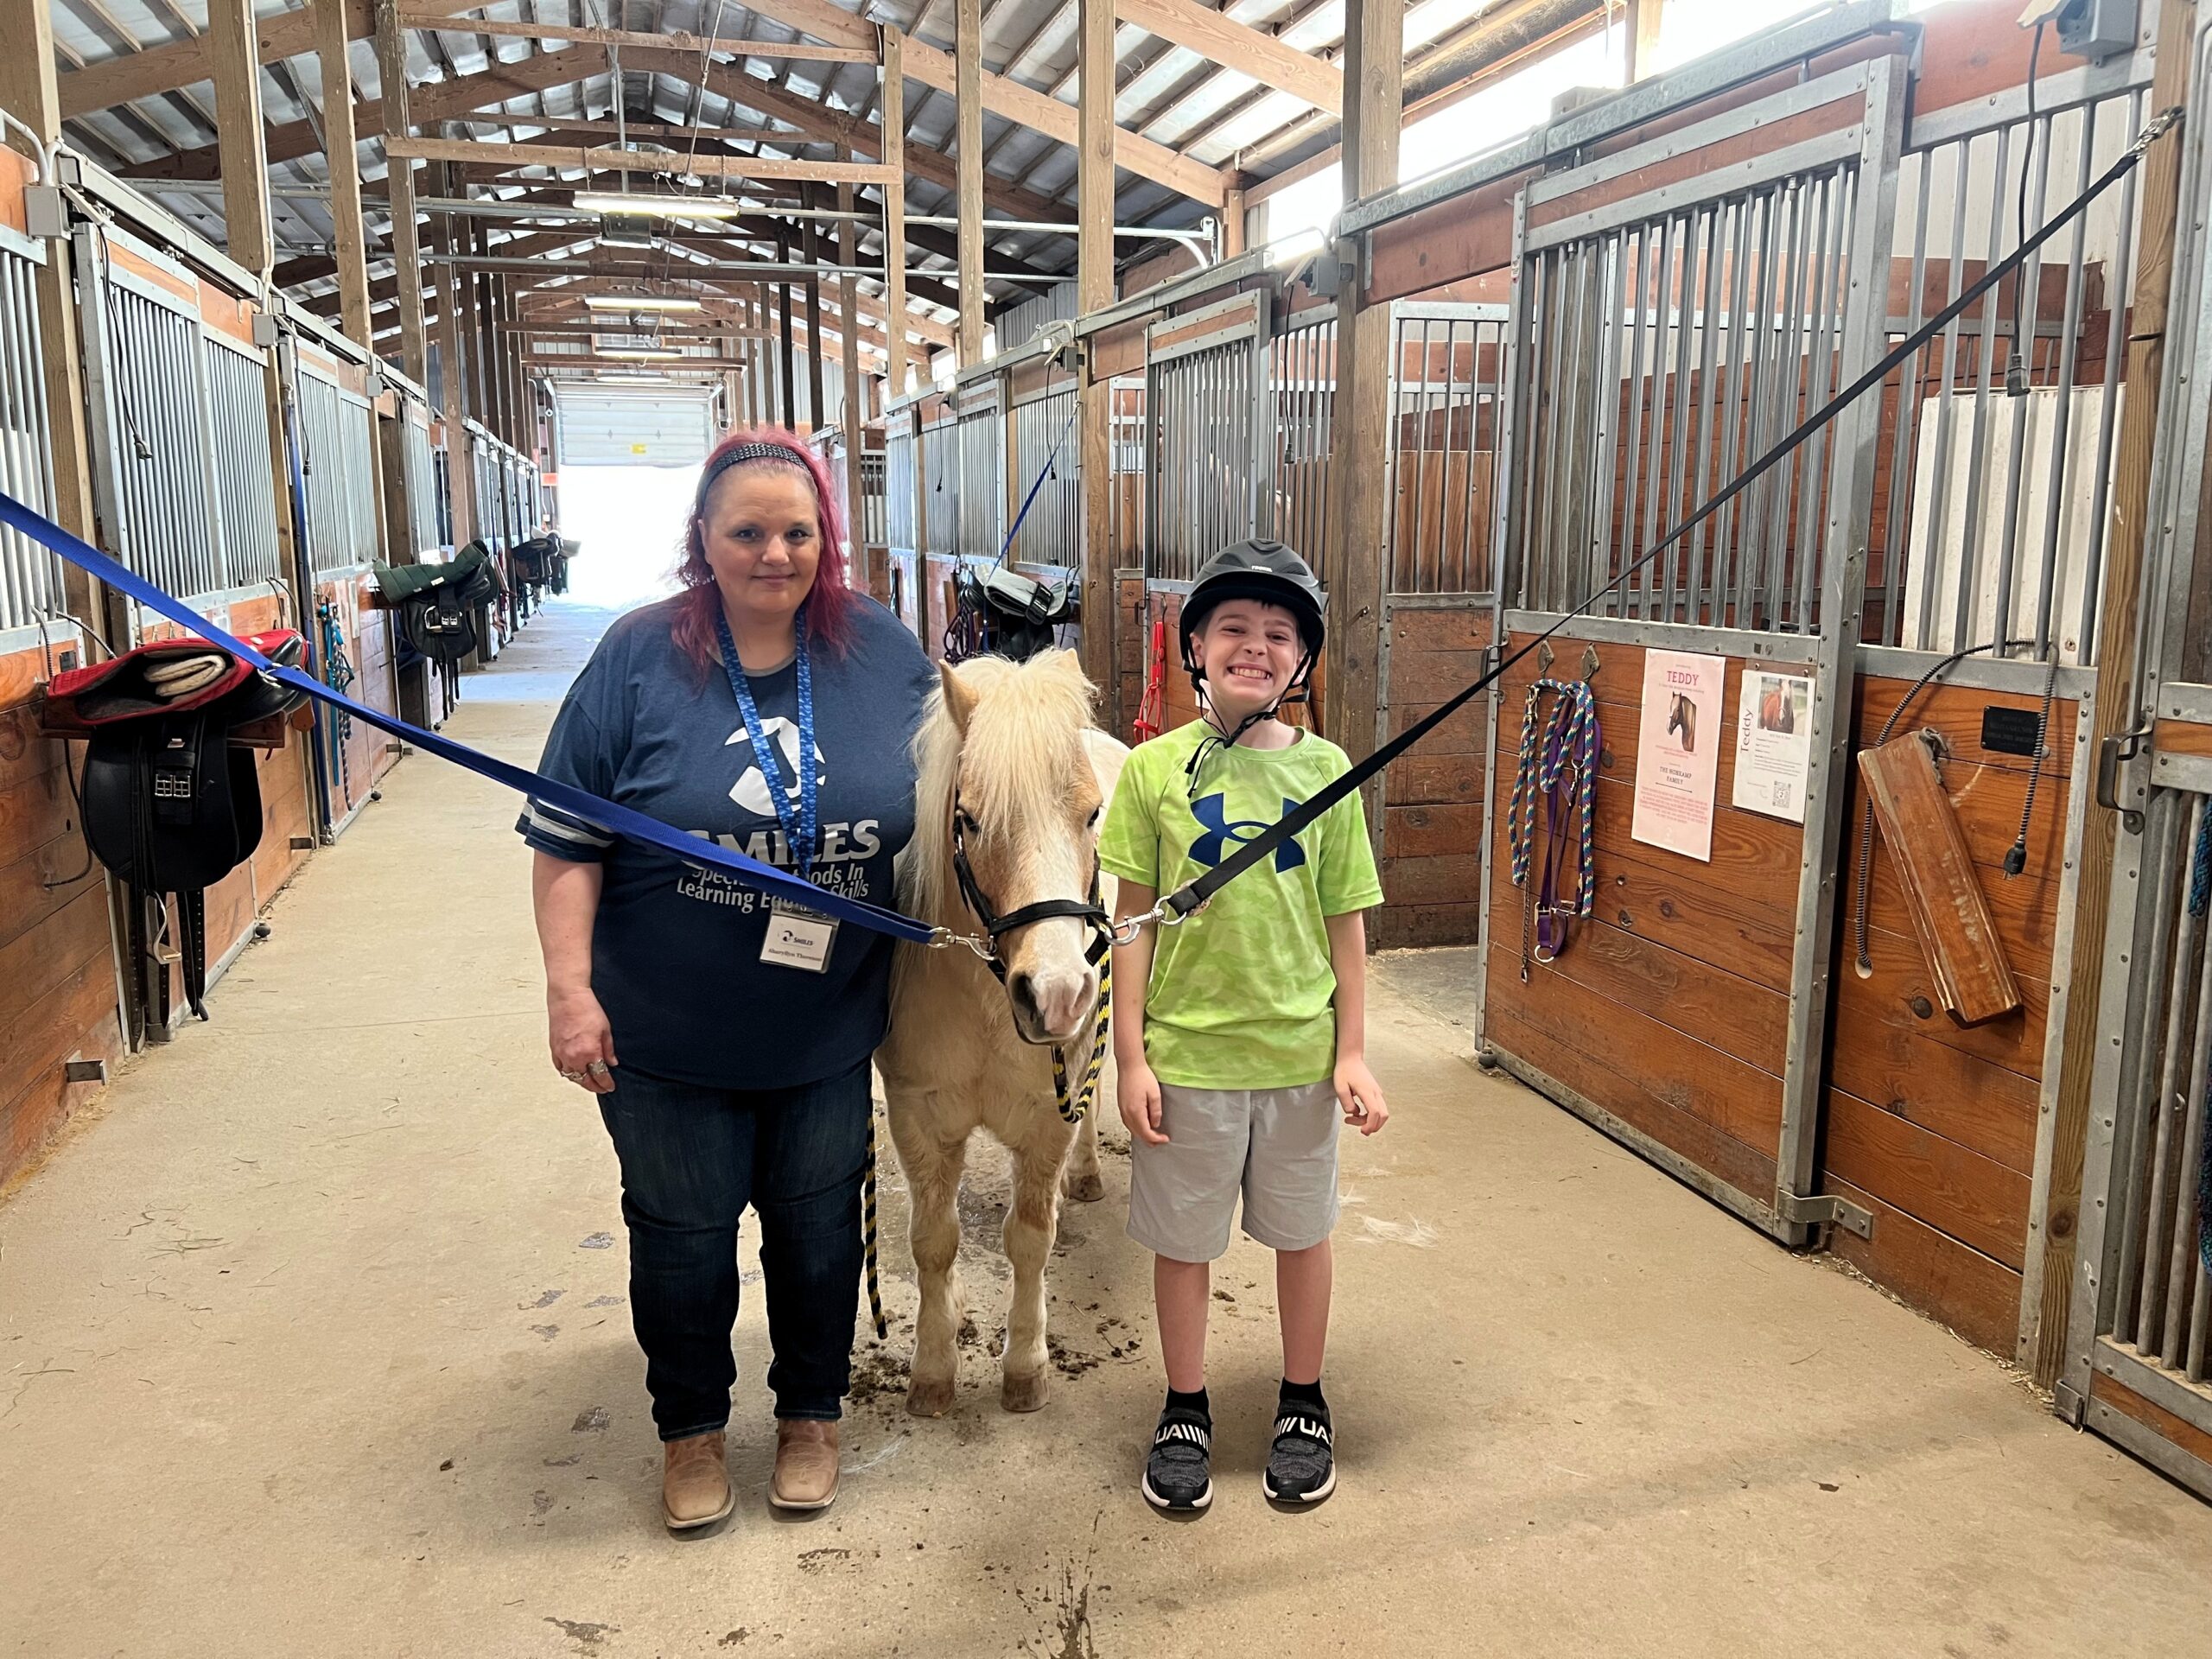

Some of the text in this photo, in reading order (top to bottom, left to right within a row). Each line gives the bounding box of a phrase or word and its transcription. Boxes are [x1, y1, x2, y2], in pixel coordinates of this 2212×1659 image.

[1667, 671, 1700, 687] TEDDY
[1739, 708, 1754, 754] Teddy
[681, 819, 880, 870] MIES
[848, 863, 864, 880] In
[677, 877, 755, 914] Learning
